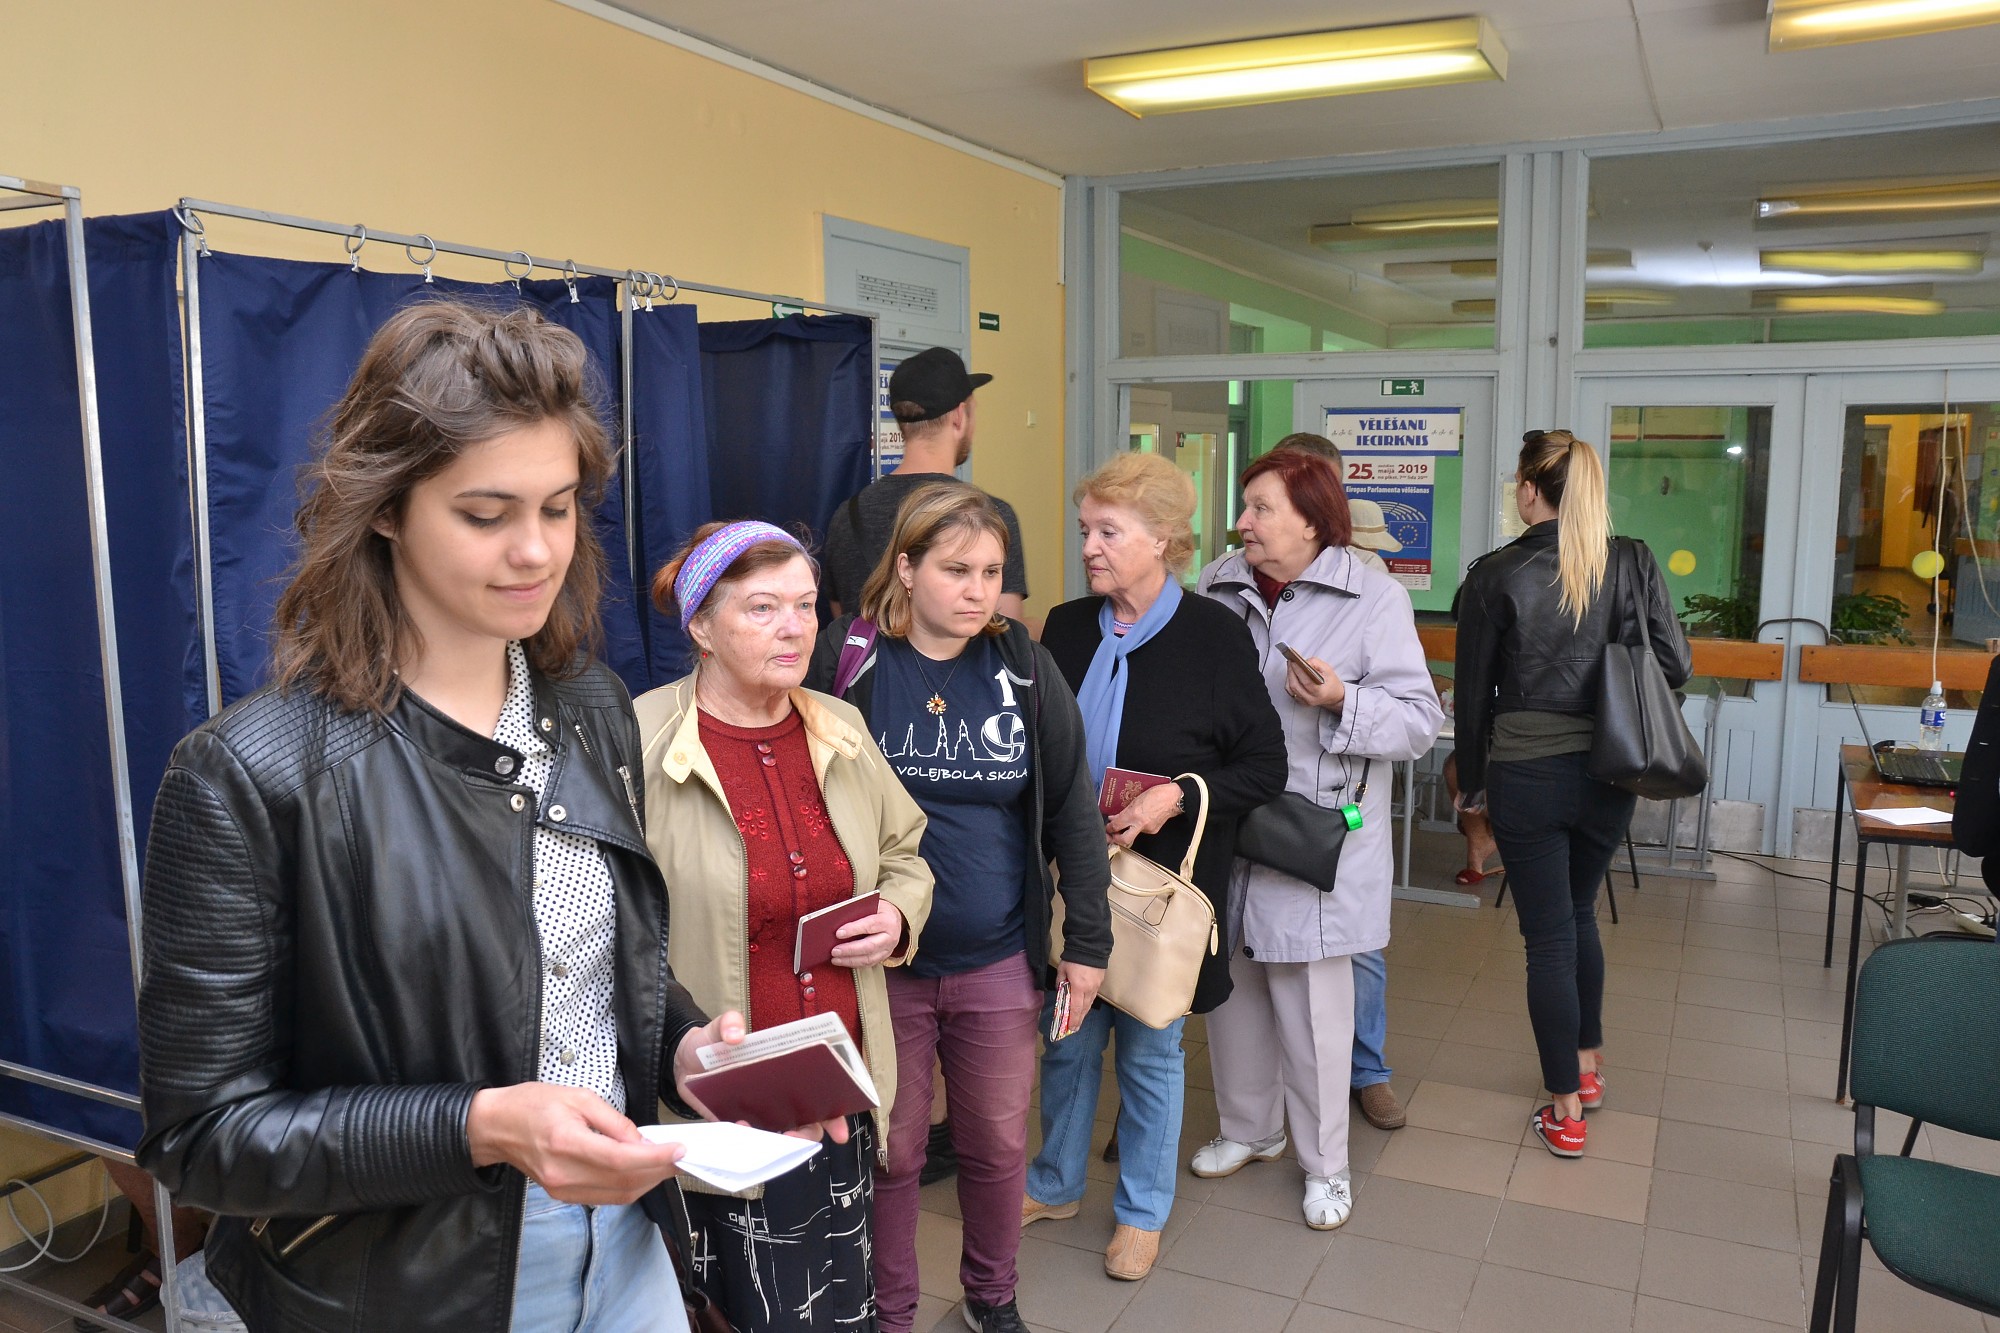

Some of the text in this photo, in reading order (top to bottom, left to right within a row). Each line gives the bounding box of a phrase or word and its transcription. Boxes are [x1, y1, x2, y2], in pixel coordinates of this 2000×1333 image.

[1359, 417, 1427, 431] VĒLĒŠANU
[1356, 435, 1429, 446] IECIRKNIS
[1348, 463, 1375, 480] 25.
[1397, 464, 1428, 474] 2019
[1345, 485, 1367, 494] Eiropas
[896, 765, 1028, 782] VOLEJBOLA SKOLA
